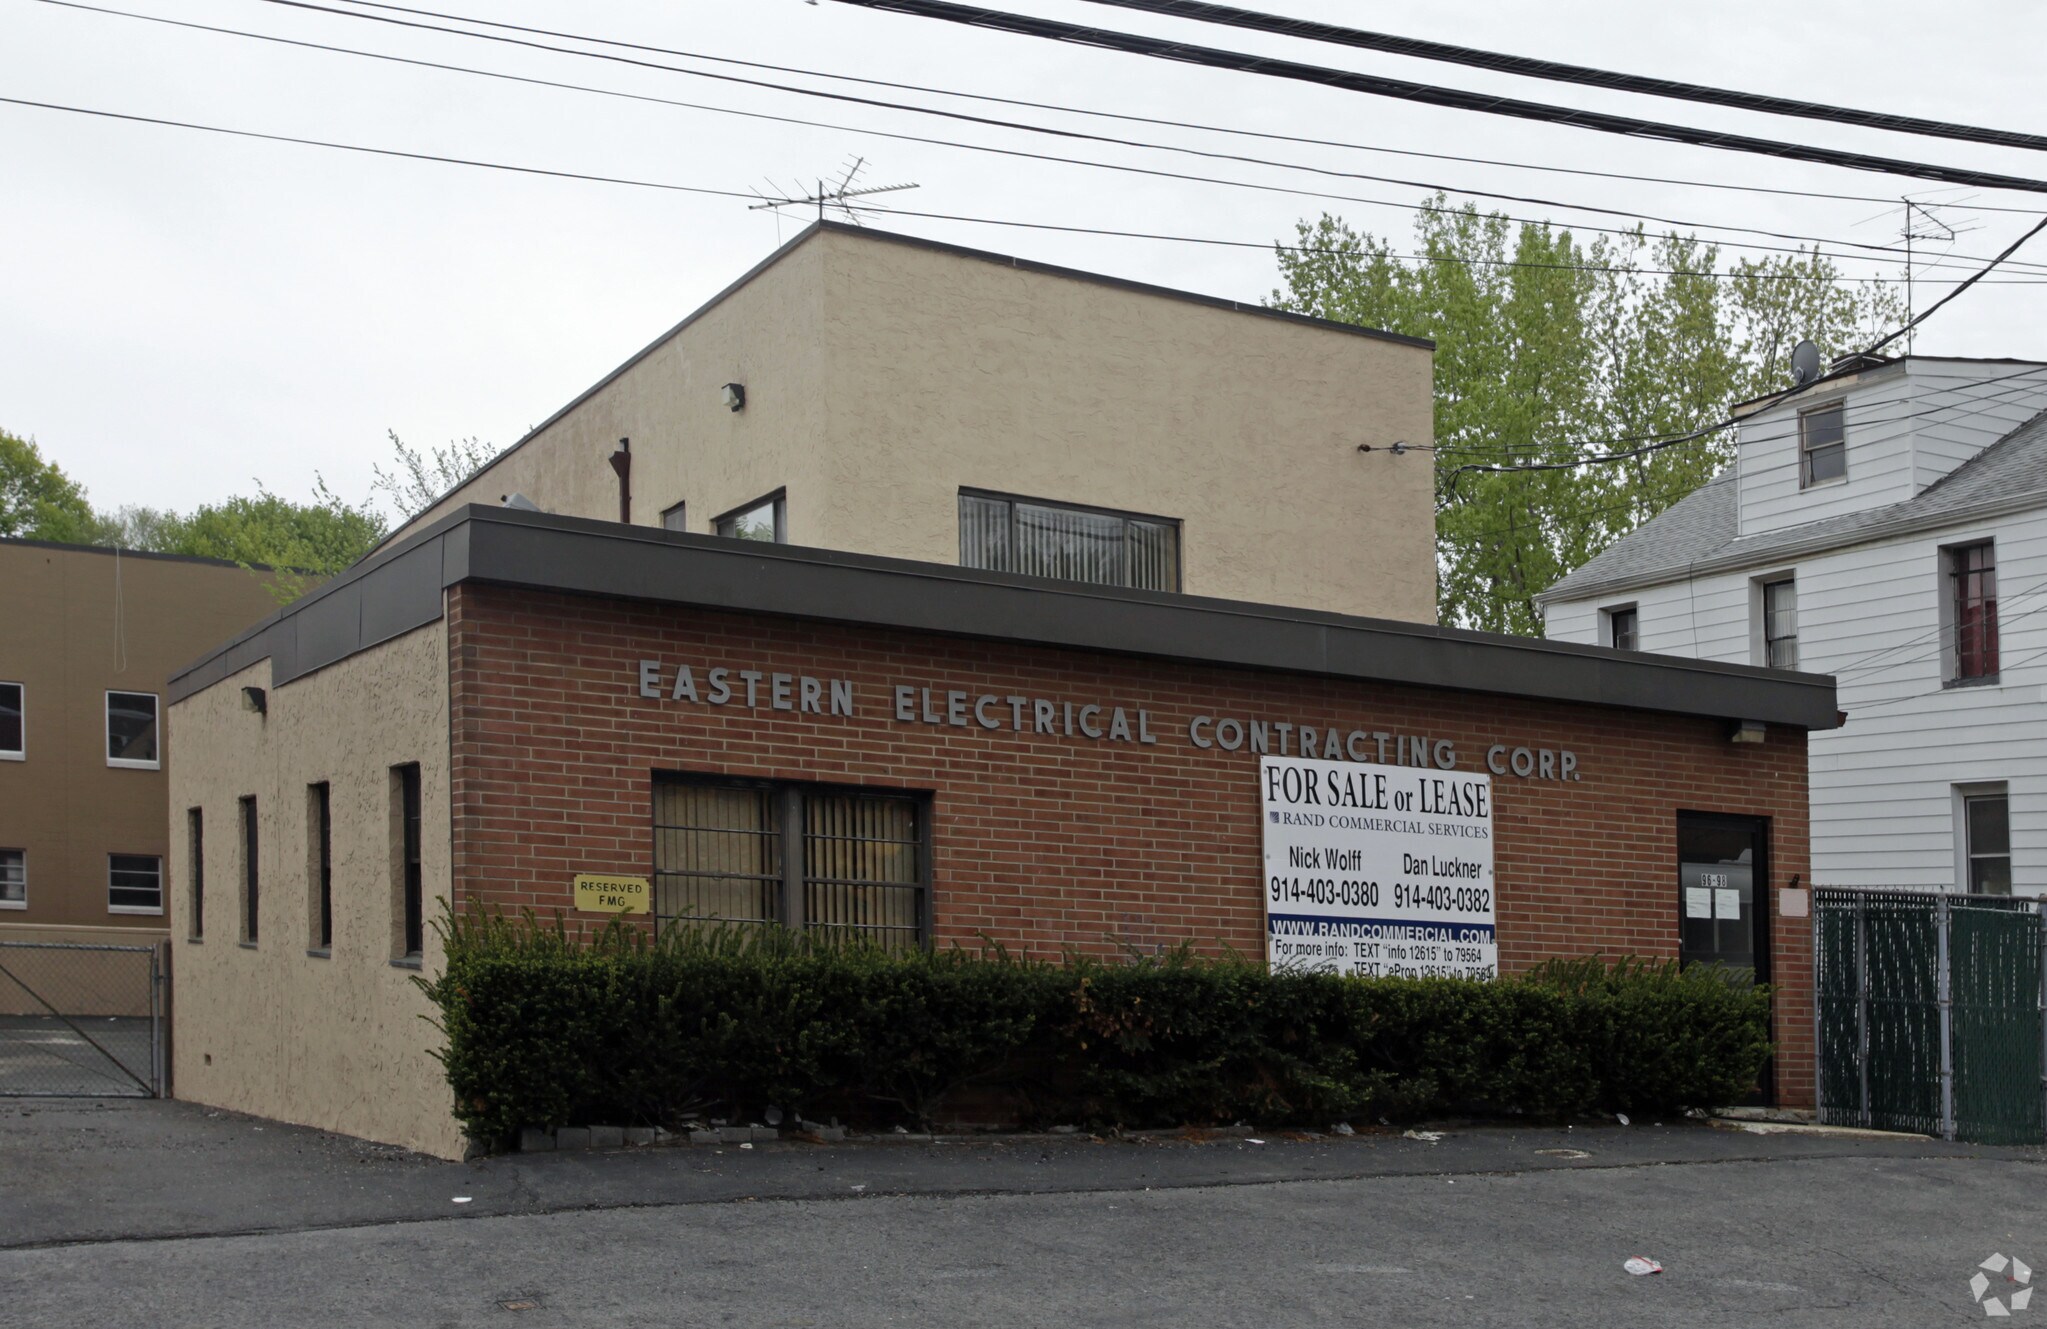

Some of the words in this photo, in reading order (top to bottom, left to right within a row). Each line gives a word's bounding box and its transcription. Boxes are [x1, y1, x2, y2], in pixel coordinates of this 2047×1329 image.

[639, 659, 853, 718] EASTERN
[895, 685, 1157, 744] ELECTRICAL
[1190, 715, 1456, 770] CONTRACTING
[1487, 744, 1581, 781] CORP.
[1266, 765, 1321, 806] FOR
[1328, 769, 1388, 810] SALE
[1395, 789, 1413, 812] or
[1419, 778, 1489, 818] LEASE
[1283, 811, 1325, 827] RAND
[1329, 815, 1425, 834] COMMERCIAL
[1428, 822, 1488, 839] SERVICES
[1289, 845, 1321, 869] Nick
[1325, 848, 1362, 872] Wolff
[1403, 852, 1428, 876] Dan
[1432, 855, 1482, 879] Luckner
[580, 881, 642, 894] RESERVED
[1702, 875, 1726, 887] 96-98
[599, 895, 625, 907] FMG
[1271, 876, 1379, 907] 914-403-0380
[1394, 883, 1490, 913] 914-403-0382
[1272, 920, 1491, 945] WWW.RANDCOMMERCIAL.COM
[1275, 939, 1293, 955] For
[1296, 943, 1322, 956] more
[1325, 941, 1348, 957] info:
[1354, 942, 1380, 958] TEXT
[1444, 947, 1453, 962] to
[1455, 947, 1482, 963] 79564
[1354, 961, 1380, 977] TEXT
